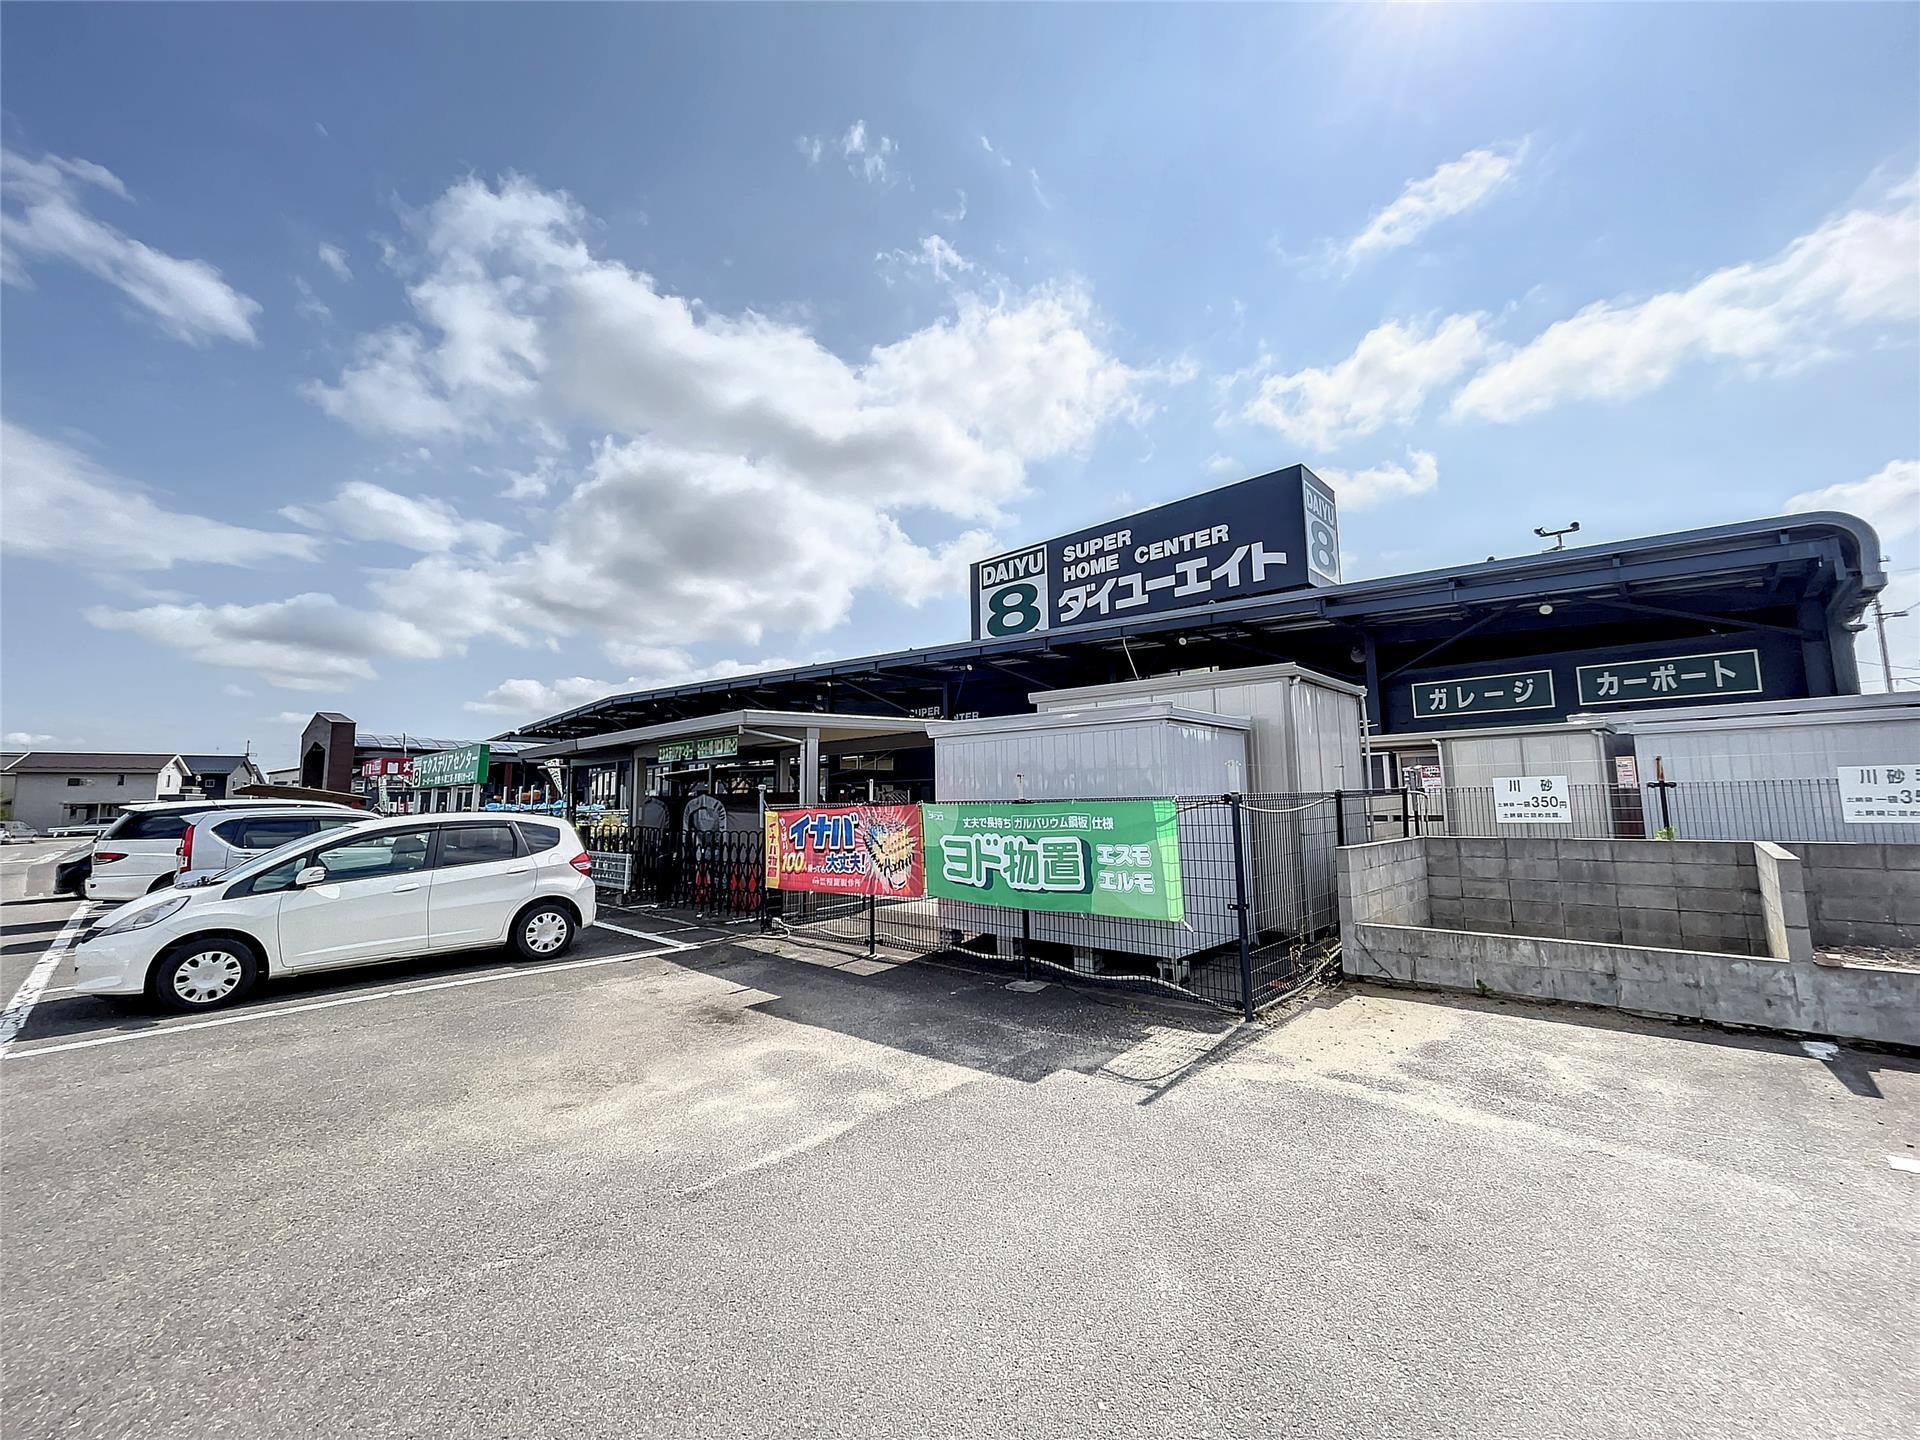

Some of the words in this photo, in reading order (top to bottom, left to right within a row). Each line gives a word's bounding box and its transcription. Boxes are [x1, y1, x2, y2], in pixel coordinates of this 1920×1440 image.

[1305, 489, 1335, 527] DAIYU
[1062, 530, 1132, 562] SUPER
[1063, 553, 1120, 583] HOME
[1134, 524, 1230, 564] CENTER
[1311, 519, 1337, 578] 8
[982, 551, 1043, 587] DAIYU
[1058, 542, 1288, 623] ダイユーエイト
[986, 582, 1042, 638] 8
[1429, 678, 1534, 711] ガレージ
[1596, 660, 1737, 696] カーポート
[414, 768, 421, 787] 8
[422, 750, 478, 774] エクステリアセンター
[789, 813, 859, 850] イナバ
[963, 816, 1012, 830] 丈夫で長持ち
[1013, 815, 1089, 830] ガルバリウム鋼板
[1091, 816, 1114, 831] 仕様
[940, 833, 1085, 893] ヨド物置
[1096, 843, 1153, 868] エスモ
[1099, 870, 1155, 895] エルモ
